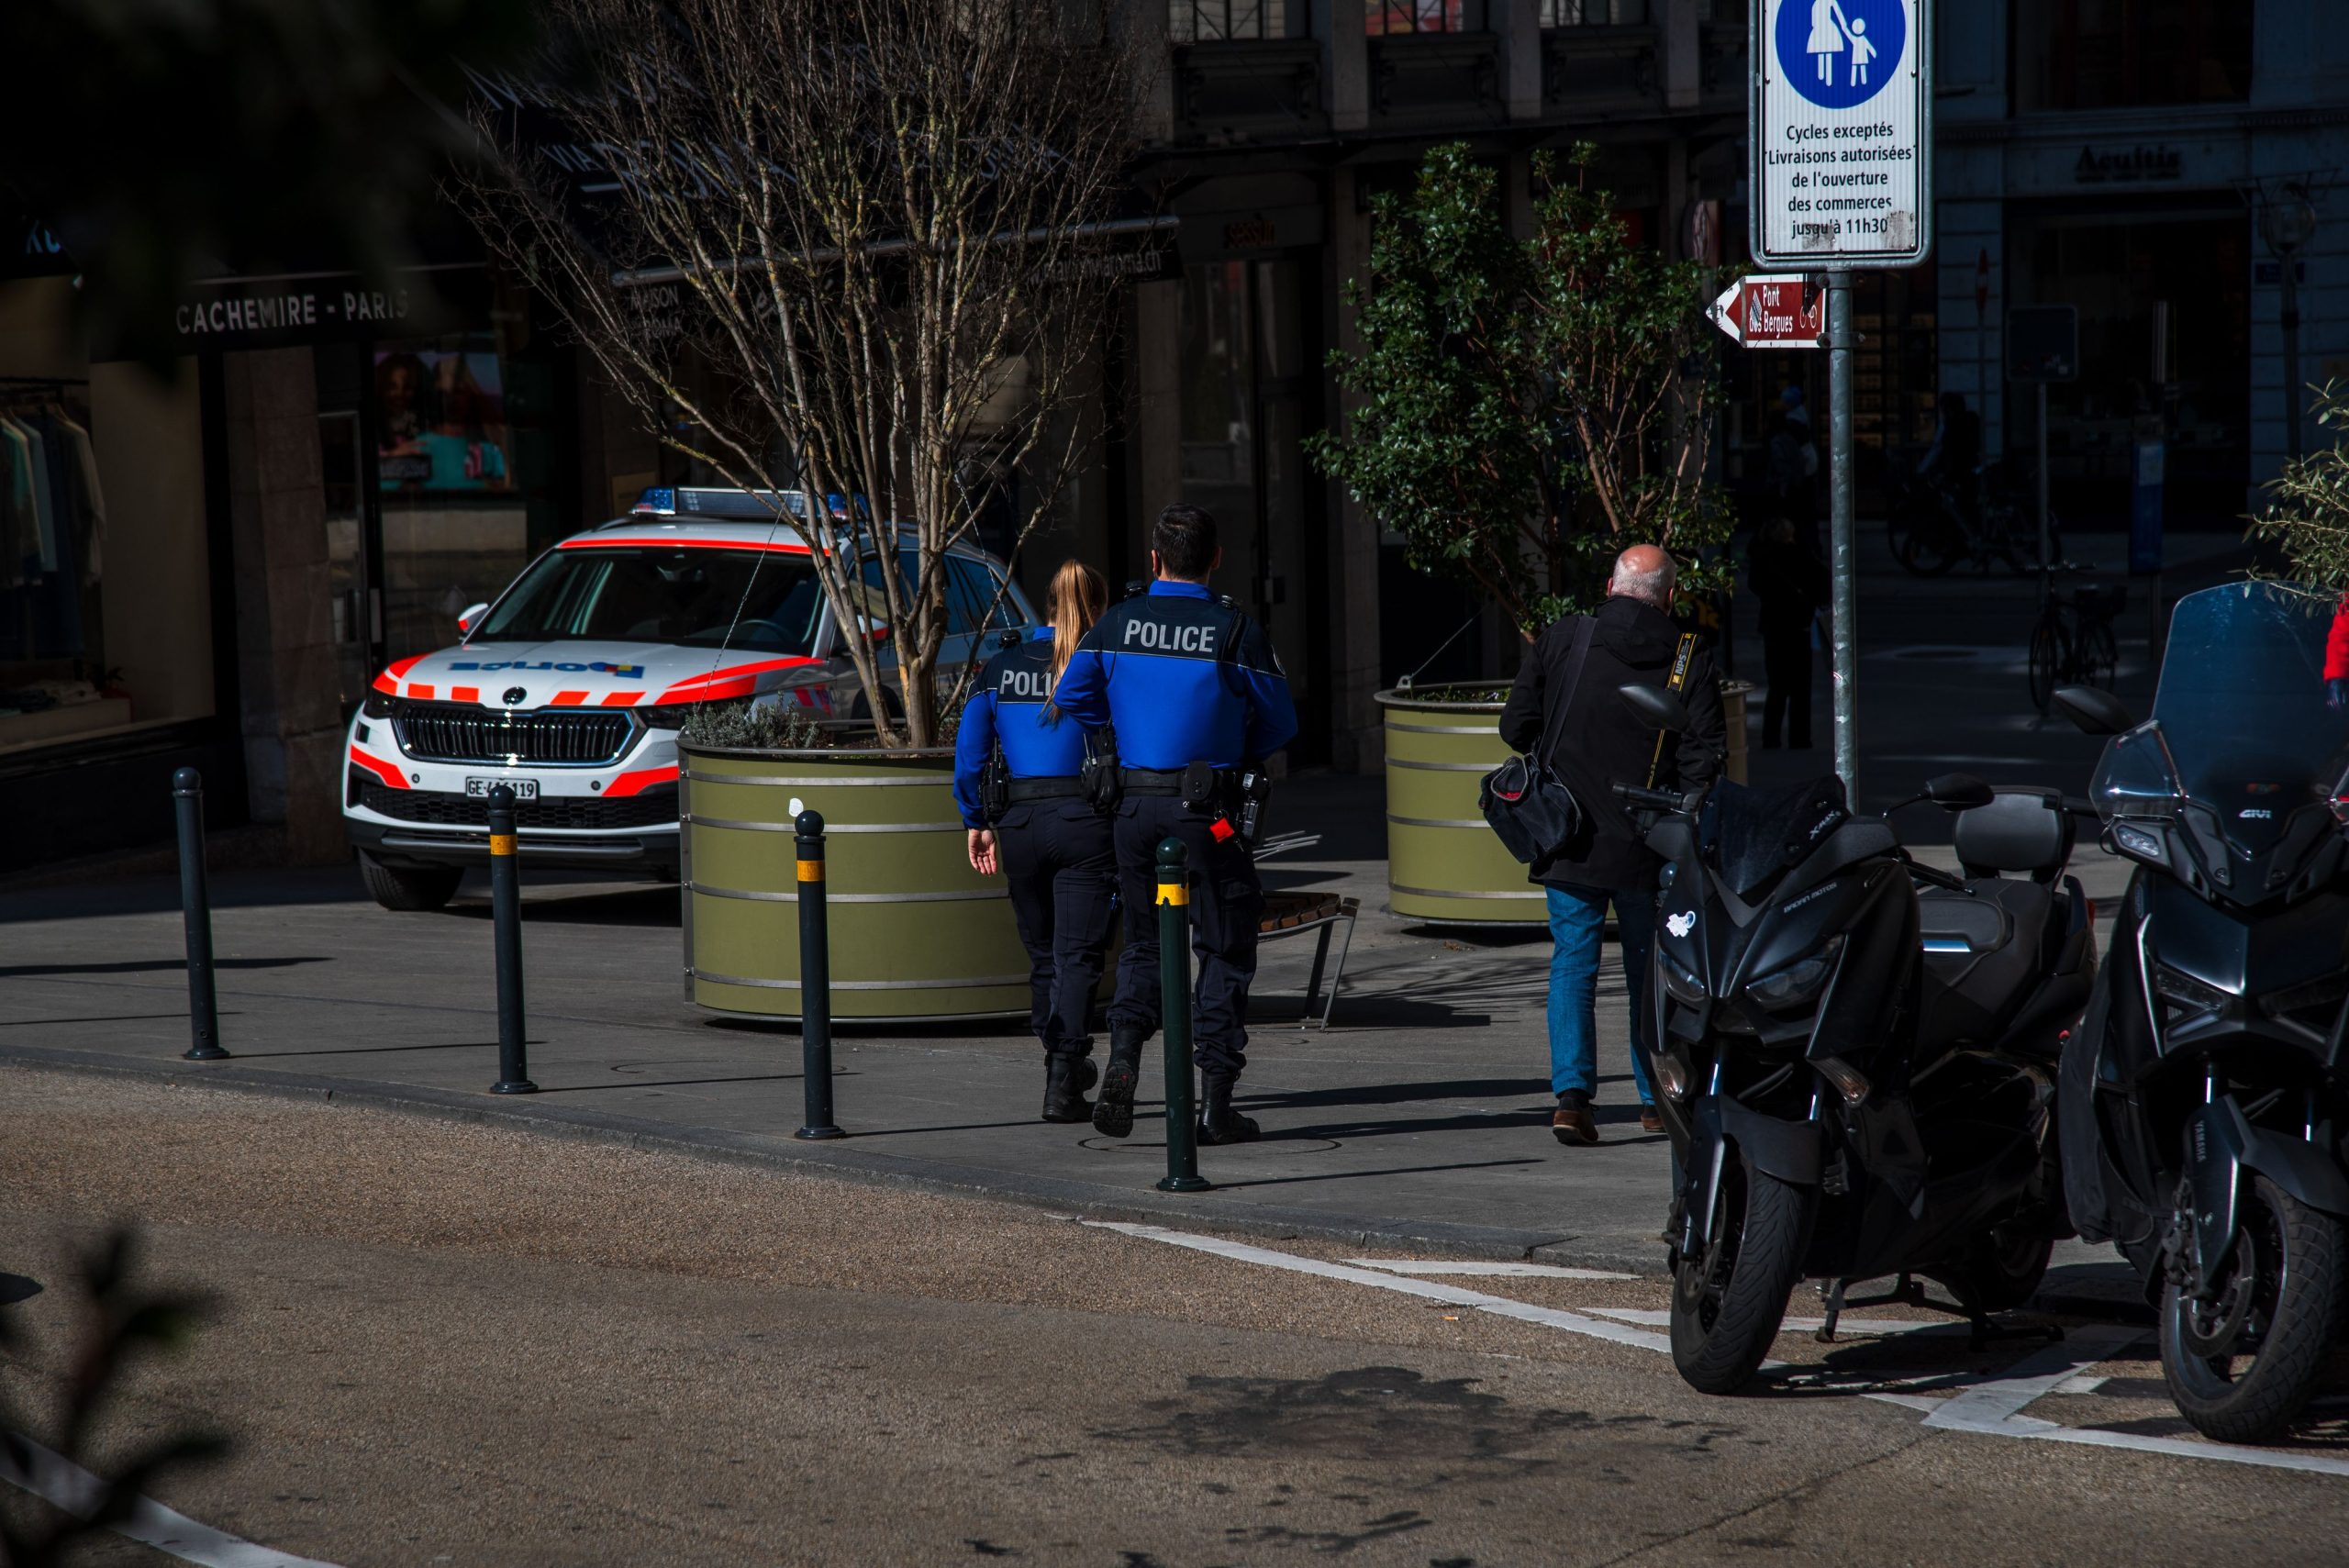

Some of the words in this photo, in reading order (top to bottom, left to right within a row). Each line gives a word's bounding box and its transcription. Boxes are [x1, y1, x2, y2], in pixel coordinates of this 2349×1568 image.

[1787, 124, 1829, 144] Cycles
[1833, 121, 1893, 141] exceptés
[1769, 149, 1836, 164] Livraisons
[1841, 145, 1912, 162] autorisées
[1792, 172, 1808, 187] de
[1813, 172, 1888, 186] l'ouverture
[1788, 196, 1810, 211] des
[1816, 196, 1892, 210] commerces
[1792, 219, 1841, 239] jusqu'à
[1846, 218, 1888, 234] 11h30
[1763, 284, 1780, 306] Pont
[176, 294, 317, 335] CACHEMIRE
[342, 289, 409, 321] PARIS
[1764, 311, 1793, 339] Bergues
[1123, 618, 1216, 652] POLICE
[449, 661, 645, 679] POLICE
[1675, 652, 1687, 674] NPS
[999, 669, 1053, 697] POLI
[2239, 808, 2273, 819] GIVI
[2194, 1119, 2207, 1162] YAMAHA
